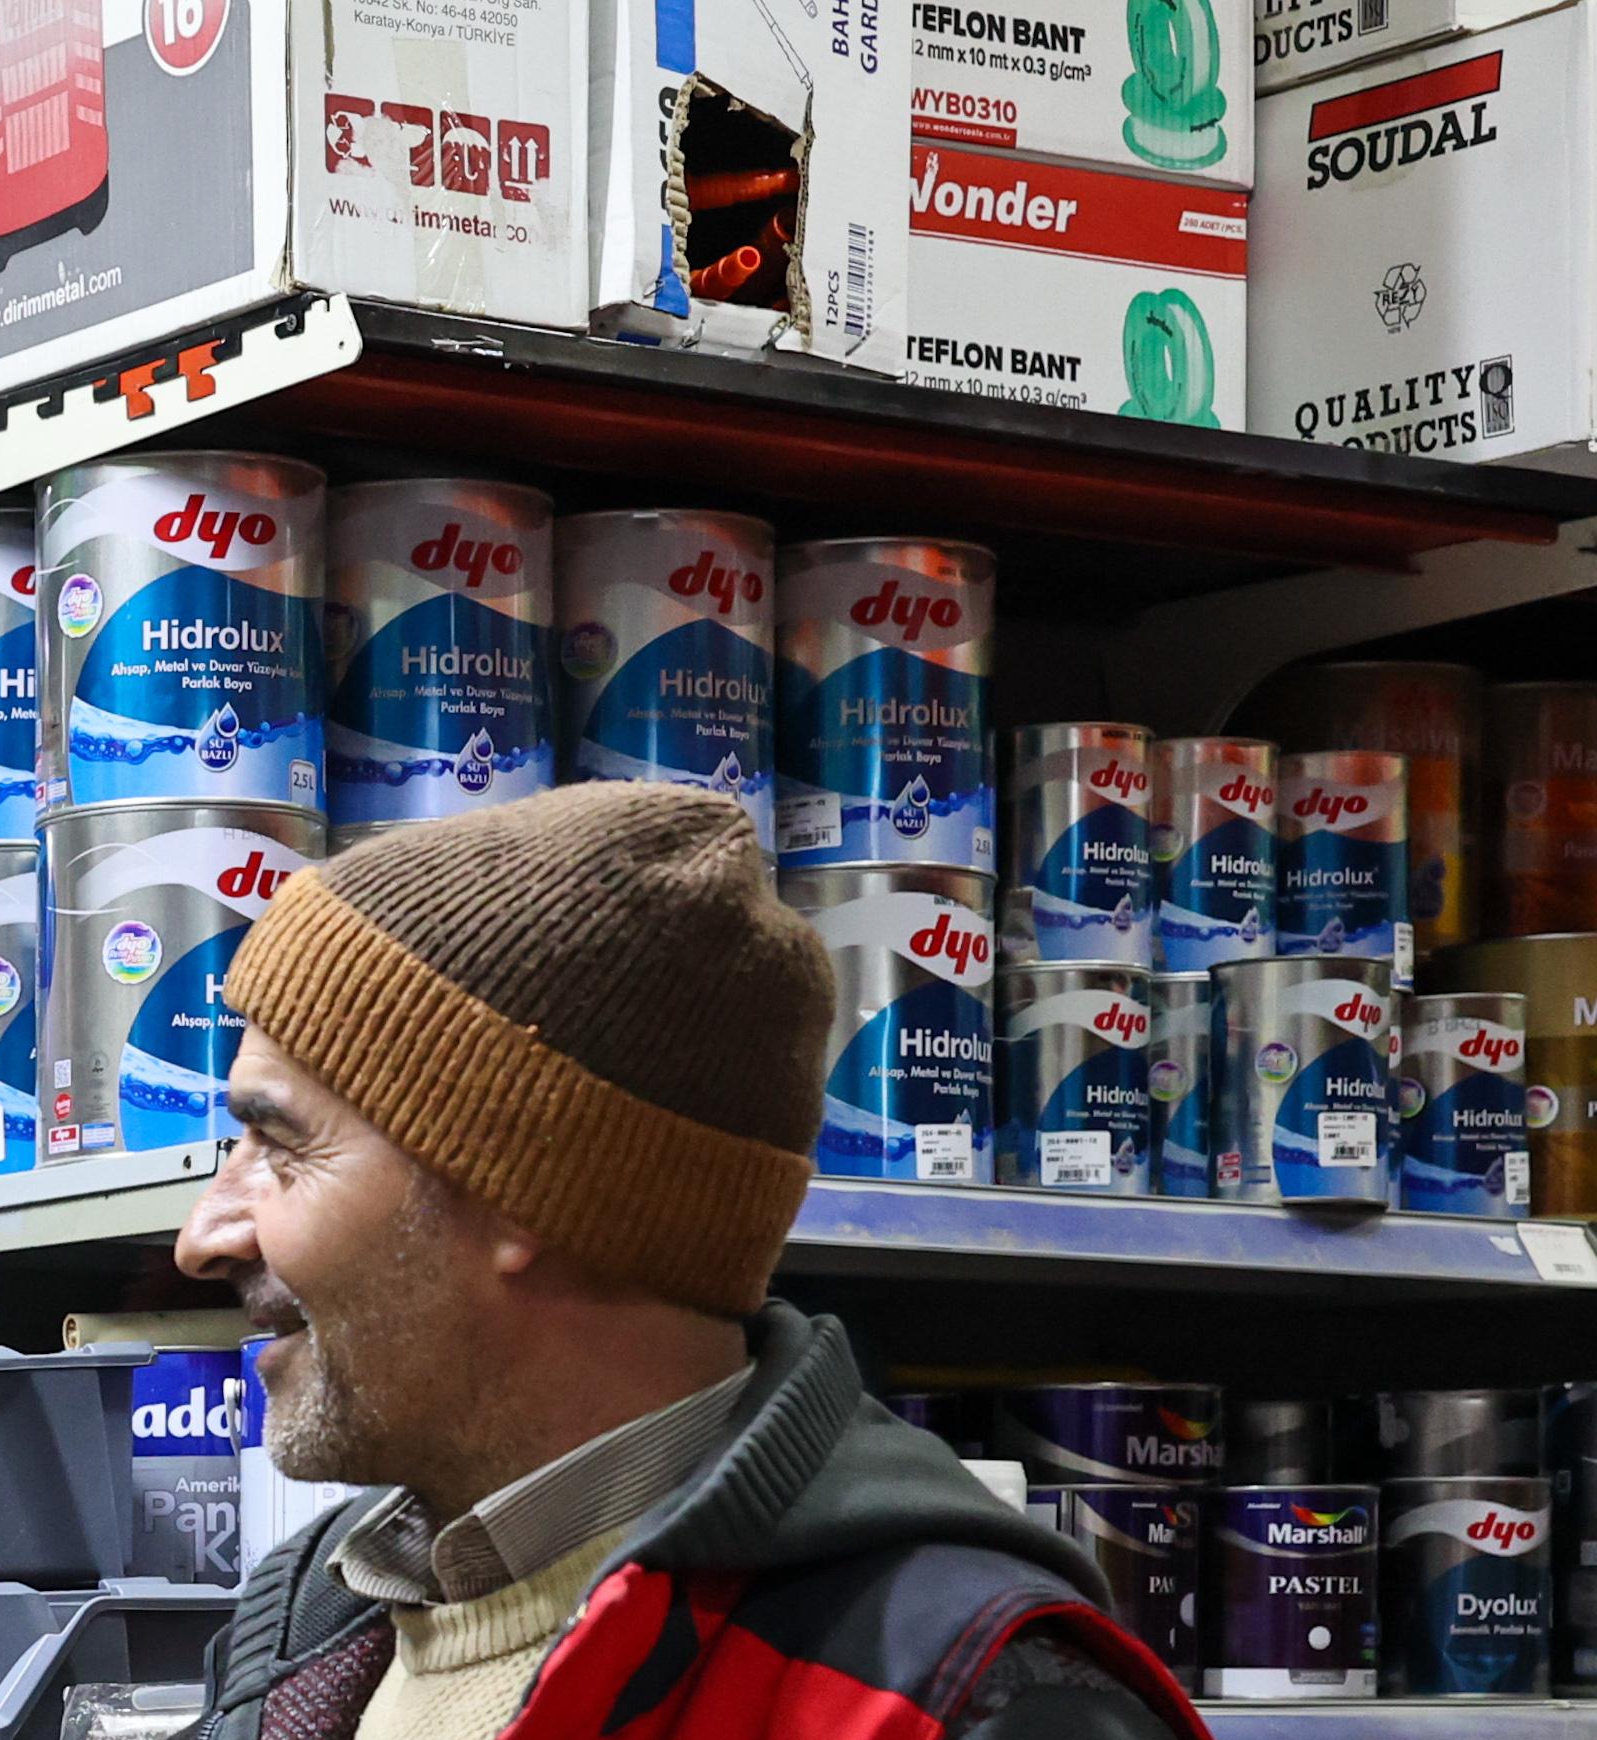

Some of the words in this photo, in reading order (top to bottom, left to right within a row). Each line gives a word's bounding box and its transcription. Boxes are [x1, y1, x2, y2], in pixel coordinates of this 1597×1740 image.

[354, 10, 445, 38] Karatay-Konya
[456, 24, 516, 47] TÜRKİYE
[417, 1, 438, 15] No:
[441, 5, 476, 21] 46-48
[480, 9, 518, 28] 42050
[1013, 18, 1086, 55] BANT
[928, 43, 955, 63] mm
[957, 48, 967, 64] x
[969, 47, 986, 67] 10
[989, 51, 1010, 70] mt
[1011, 56, 1021, 72] x
[1023, 55, 1046, 76] 0.3
[1307, 101, 1497, 190] SOUDAL
[826, 269, 841, 329] 12PCS
[1011, 349, 1082, 382] BANT
[924, 375, 952, 392] mm
[955, 380, 964, 393] x
[966, 379, 984, 396] 10
[987, 382, 1006, 400] mt
[1008, 387, 1018, 400] x
[1020, 386, 1043, 405] 0.3
[1295, 364, 1475, 441] QUALITY
[154, 494, 277, 559] dyo
[411, 523, 524, 588] dyo
[668, 551, 764, 615] dyo
[850, 580, 963, 641] dyo
[142, 619, 285, 654] Hidrolux
[111, 662, 152, 678] Ahşap,
[155, 657, 189, 673] Metal
[191, 663, 206, 673] ve
[209, 661, 244, 674] Duvar
[402, 646, 535, 680] Hidrolux
[182, 676, 221, 690] Parlak
[223, 677, 253, 694] Boya
[660, 668, 769, 706] Hidrolux
[440, 701, 478, 716] Parlak
[479, 702, 506, 717] Boya
[839, 698, 969, 729] Hidrolux
[695, 724, 727, 738] Parlak
[201, 749, 232, 761] BAZLI
[916, 751, 942, 765] Boya
[1090, 759, 1148, 798] dyo
[1219, 774, 1274, 813] dyo
[1293, 788, 1369, 824] dyo
[1286, 867, 1375, 887] Hidrolux
[910, 913, 989, 975] dyo
[171, 1012, 214, 1029] Ahşap,
[1094, 1002, 1147, 1042] dyo
[1334, 993, 1382, 1033] dyo
[1459, 1030, 1520, 1067] dyo
[1453, 1109, 1523, 1128] Hidrolux
[1267, 1522, 1366, 1545] Marshall
[1467, 1511, 1535, 1550] dyo
[1268, 1575, 1363, 1595] PASTEL
[1457, 1592, 1538, 1621] Dyolux
